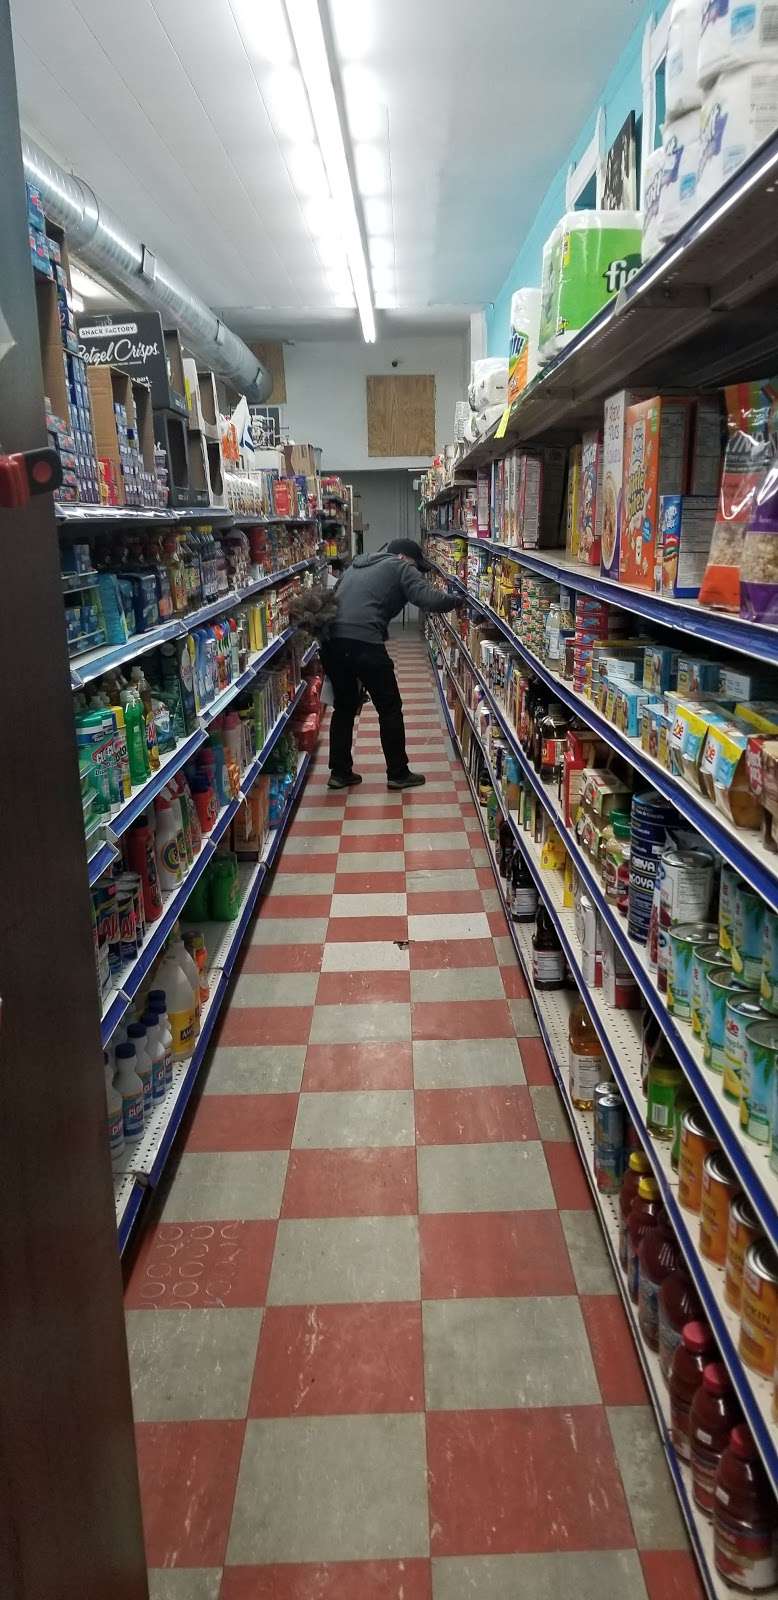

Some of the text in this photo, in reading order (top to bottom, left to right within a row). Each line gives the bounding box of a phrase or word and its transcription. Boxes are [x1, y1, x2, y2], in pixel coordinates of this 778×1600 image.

[81, 325, 135, 337] SNACK FACTORY
[114, 338, 158, 364] Crisps
